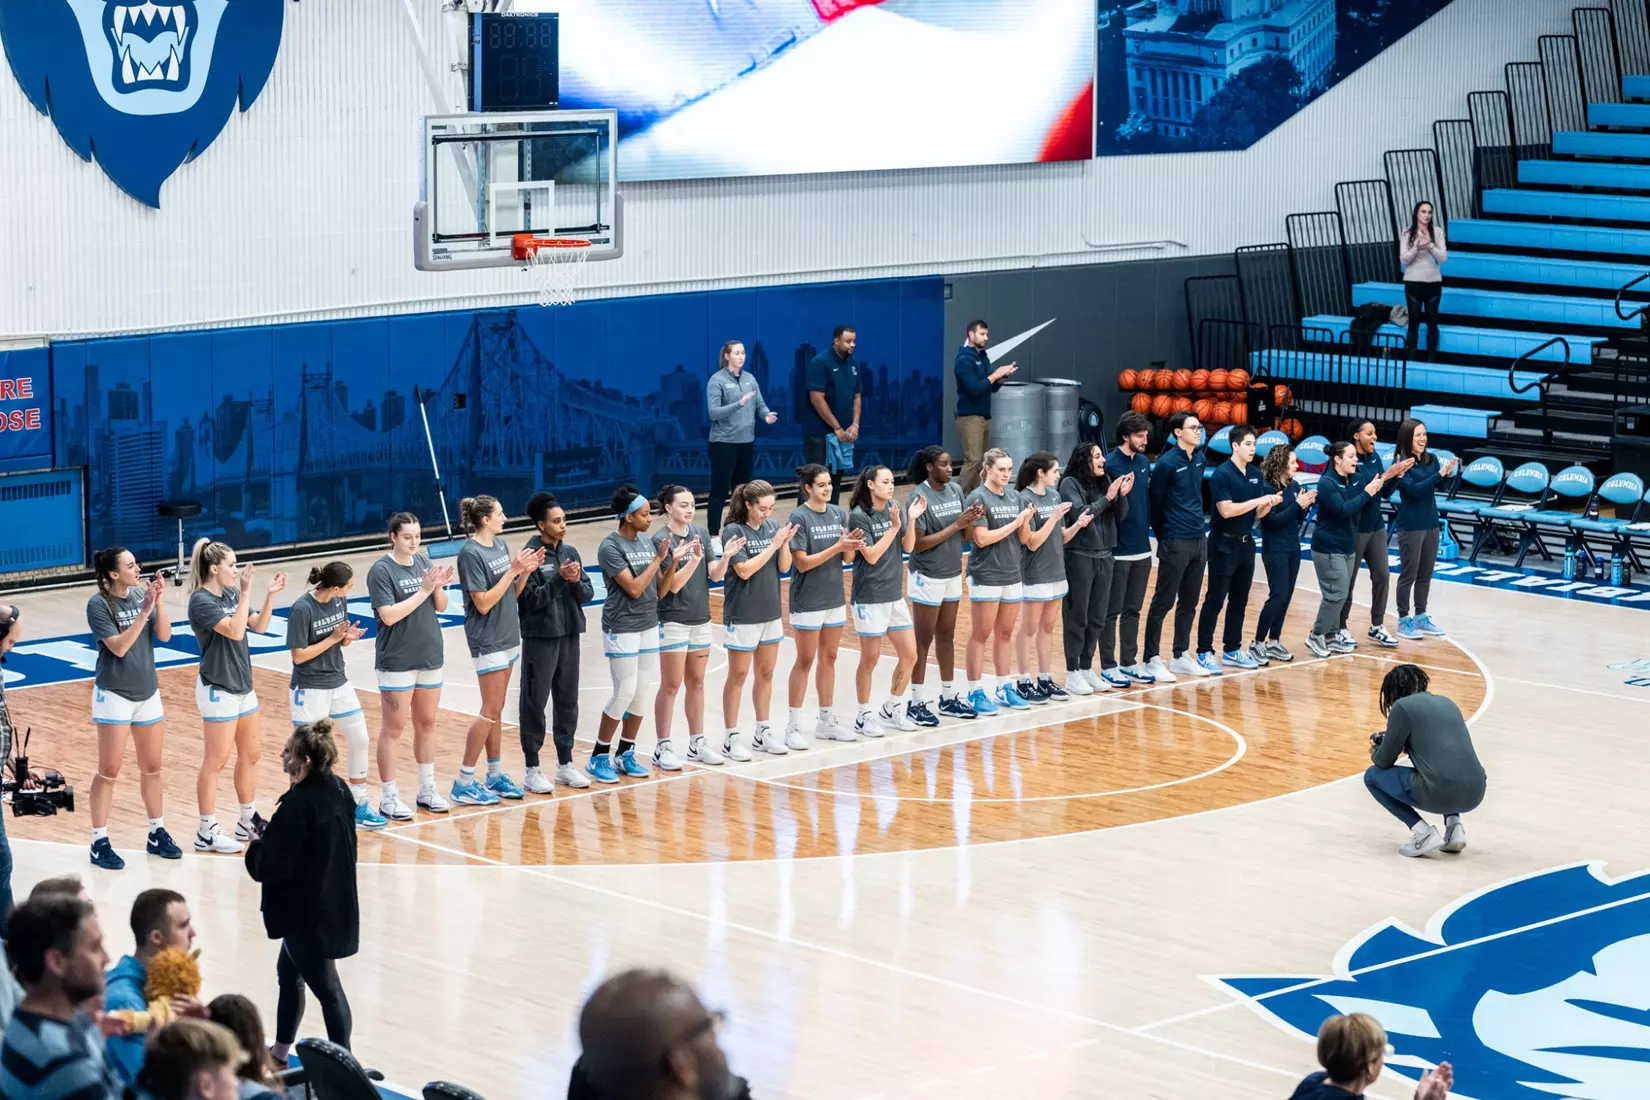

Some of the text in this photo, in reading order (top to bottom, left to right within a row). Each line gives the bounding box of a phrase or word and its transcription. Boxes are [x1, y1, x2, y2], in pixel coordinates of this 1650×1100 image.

[0, 377, 33, 400] RE
[1469, 462, 1498, 473] COLUMBIA
[1514, 469, 1543, 480] COLUMBIA
[1558, 472, 1588, 485] COLUMBIA
[1606, 479, 1638, 491] COLUMBIA
